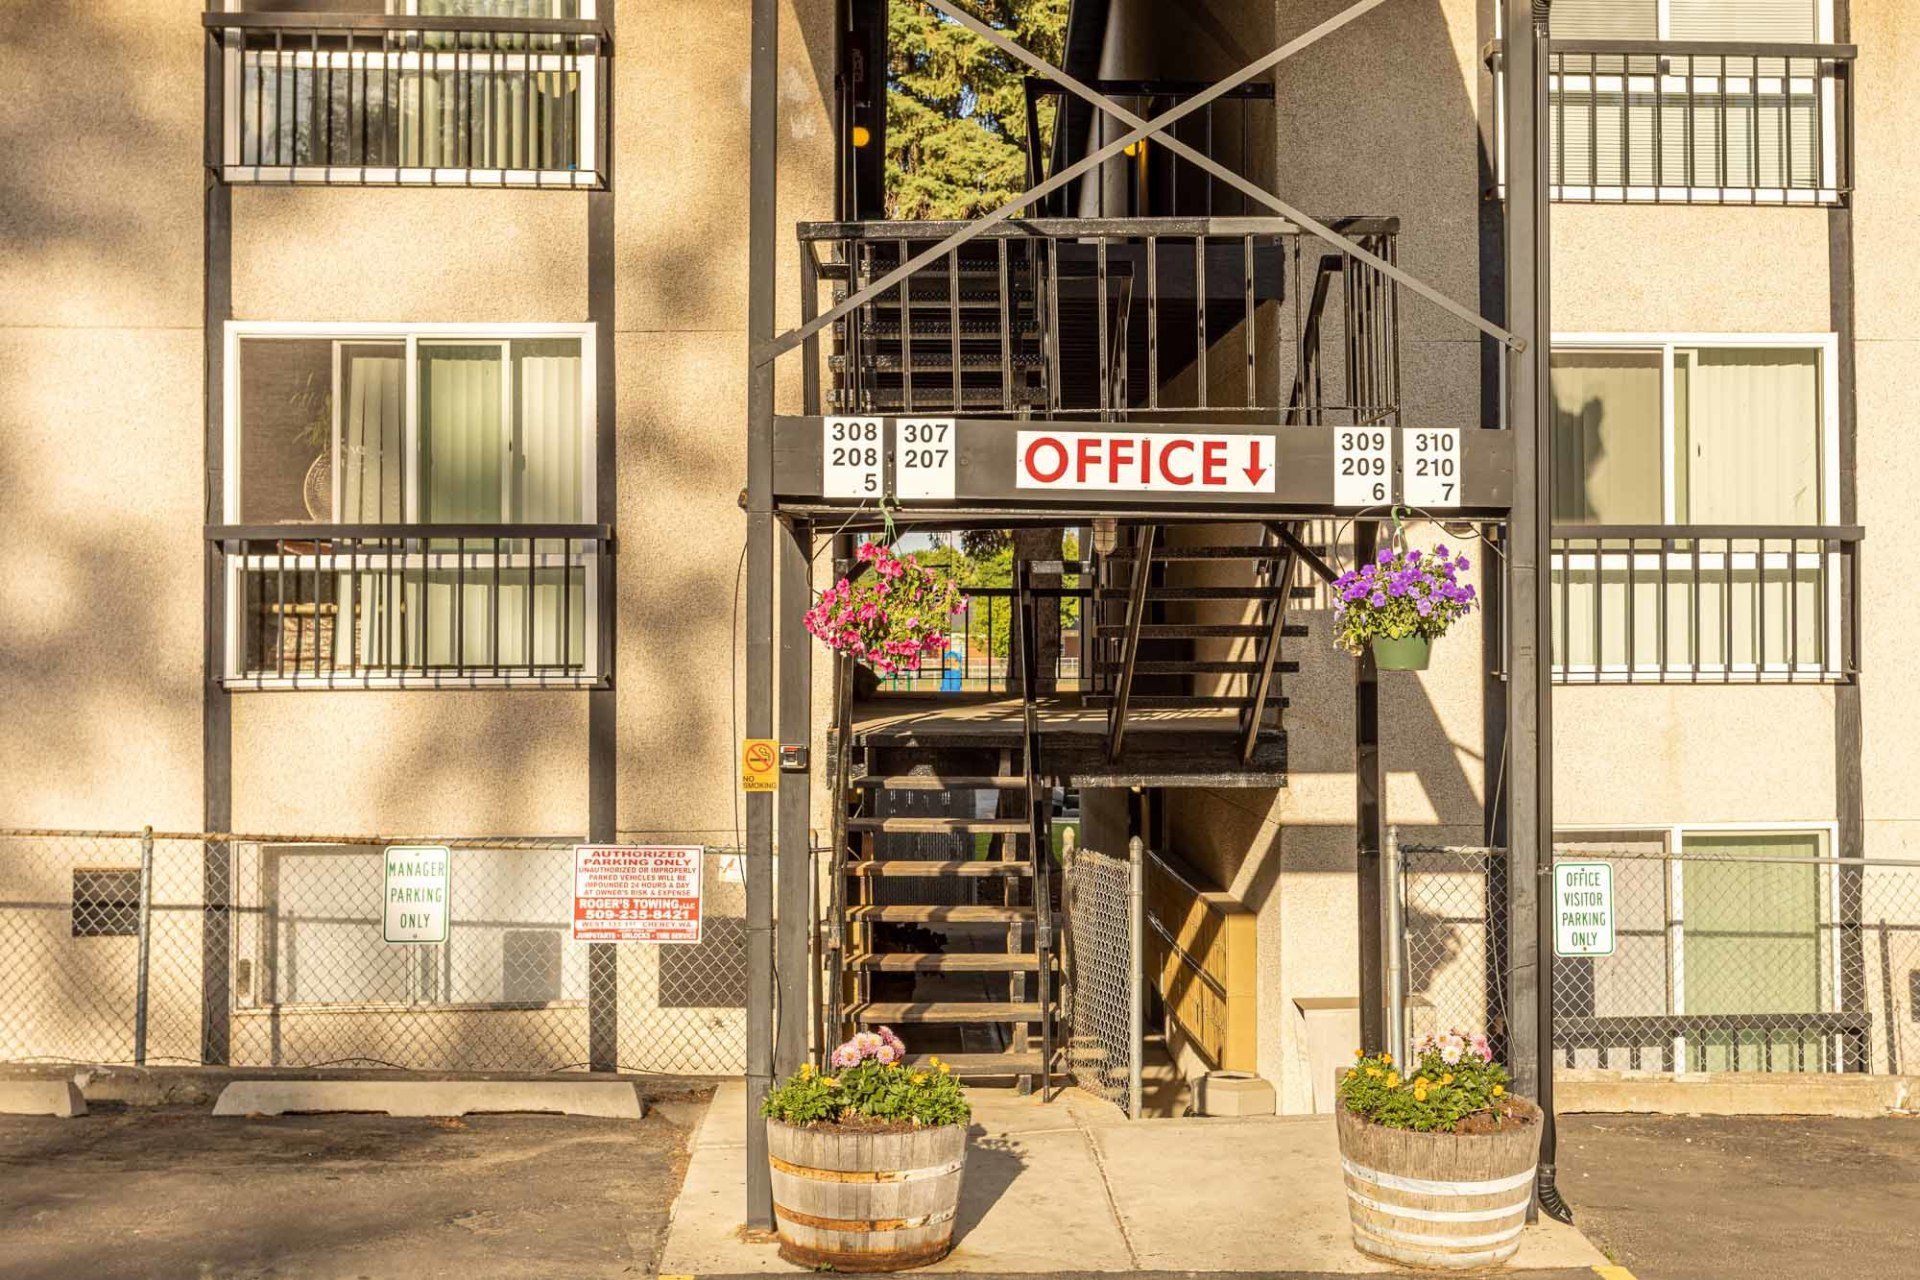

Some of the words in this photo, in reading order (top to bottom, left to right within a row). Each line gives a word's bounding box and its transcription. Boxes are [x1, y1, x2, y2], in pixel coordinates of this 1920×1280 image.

[832, 422, 878, 441] 308
[904, 424, 949, 443] 307
[1341, 432, 1385, 451] 309
[1415, 433, 1454, 452] 310
[832, 448, 878, 467] 208
[904, 450, 949, 468] 207
[1024, 436, 1228, 486] OFFICE
[1341, 457, 1385, 476] 209
[1416, 458, 1454, 477] 210
[864, 473, 877, 492] 5
[1372, 482, 1385, 501] 6
[1441, 483, 1455, 501] 7
[742, 775, 755, 783] NO
[583, 858, 649, 866] PARKING
[653, 858, 692, 866] ONLY
[591, 850, 686, 858] AUTHORIZED
[388, 862, 445, 877] MANAGER
[1566, 872, 1601, 887] OFFICE
[390, 887, 443, 903] PARKING
[579, 898, 631, 909] ROGER'S
[1564, 892, 1603, 907] VISITOR
[400, 913, 431, 929] ONLY
[584, 909, 690, 920] 509-235-8421
[1562, 912, 1606, 926] PARKING
[1571, 932, 1597, 946] ONLY
